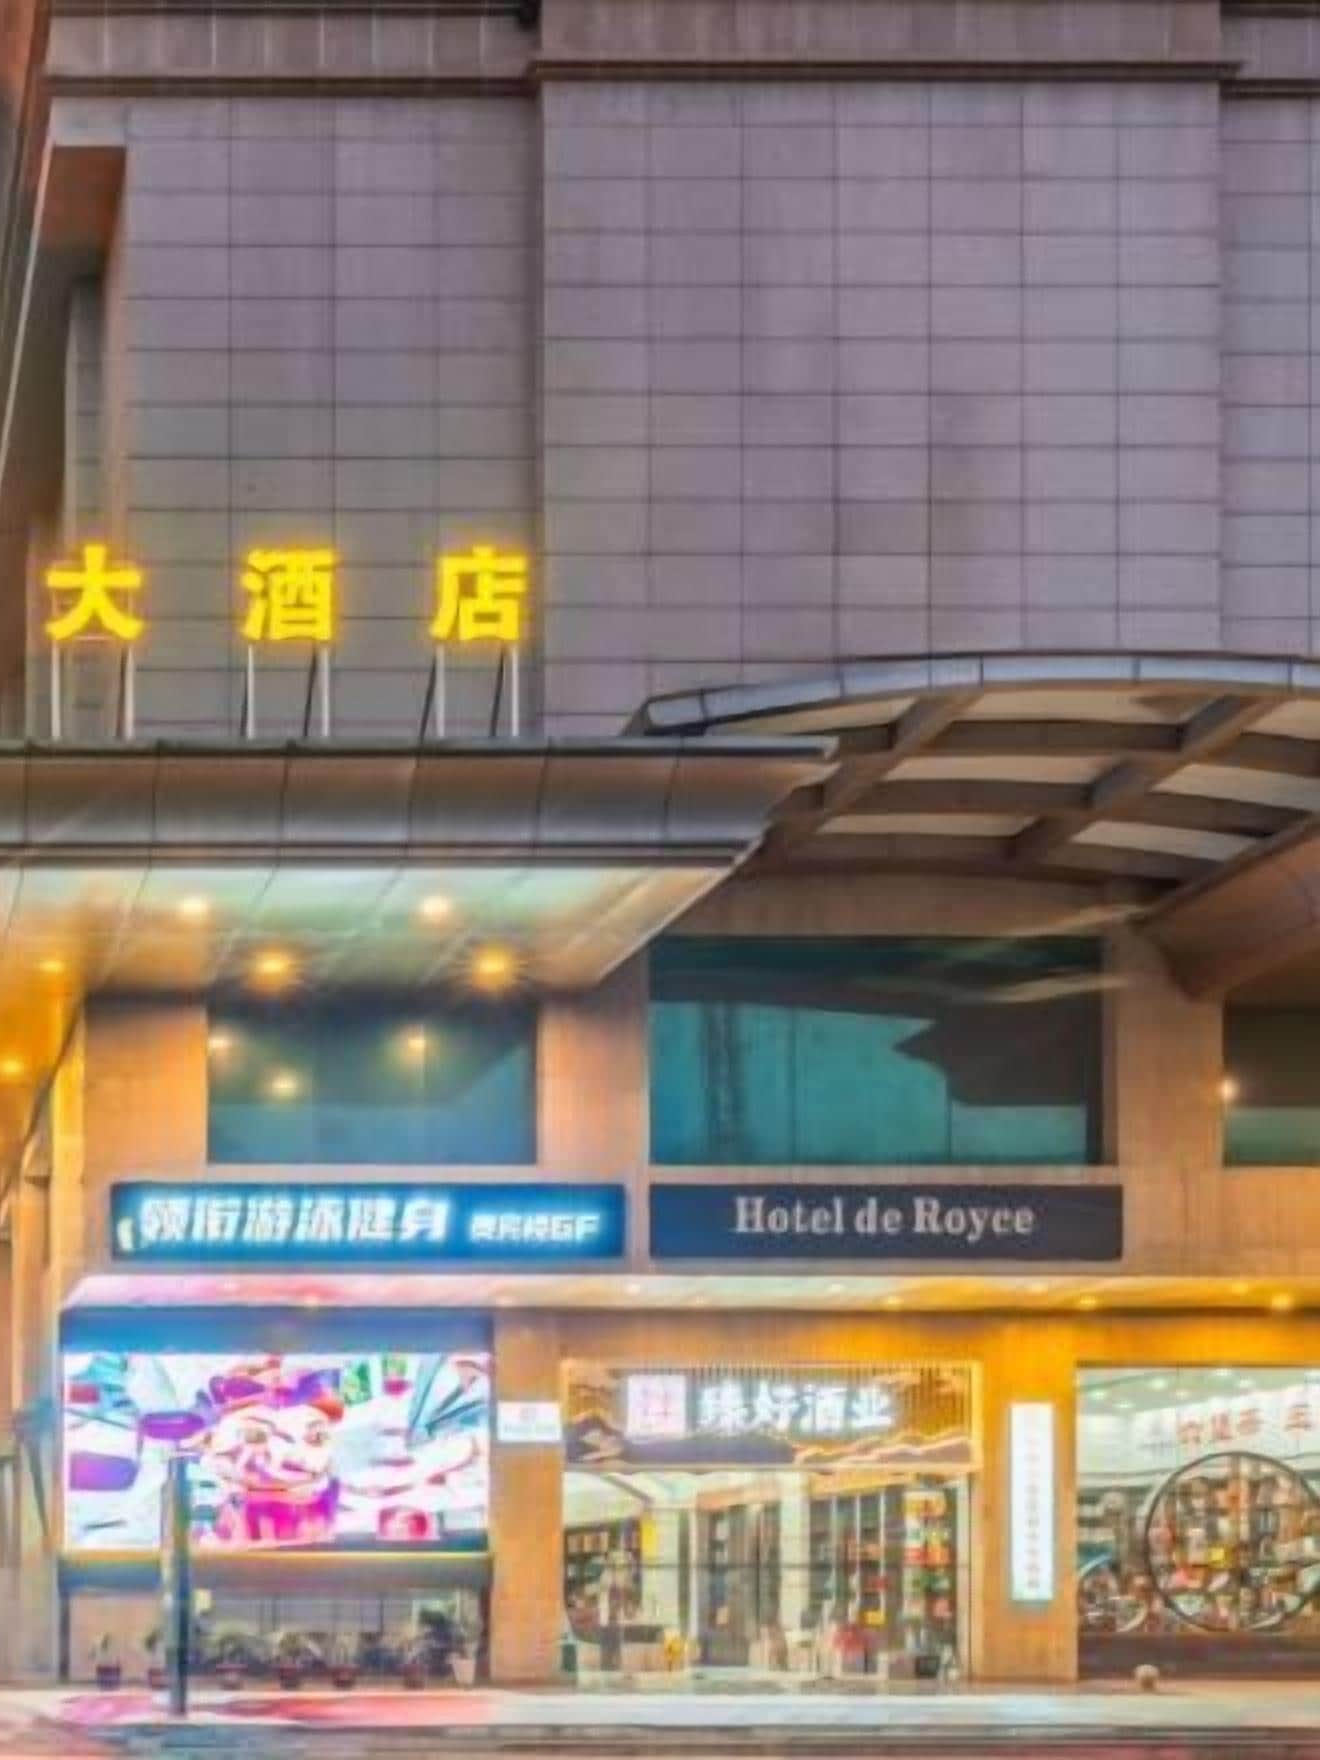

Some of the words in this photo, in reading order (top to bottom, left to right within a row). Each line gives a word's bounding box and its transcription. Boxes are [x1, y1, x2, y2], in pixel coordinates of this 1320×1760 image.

[733, 1196, 843, 1235] Hotel
[854, 1197, 903, 1235] de
[913, 1196, 1036, 1243] Royce
